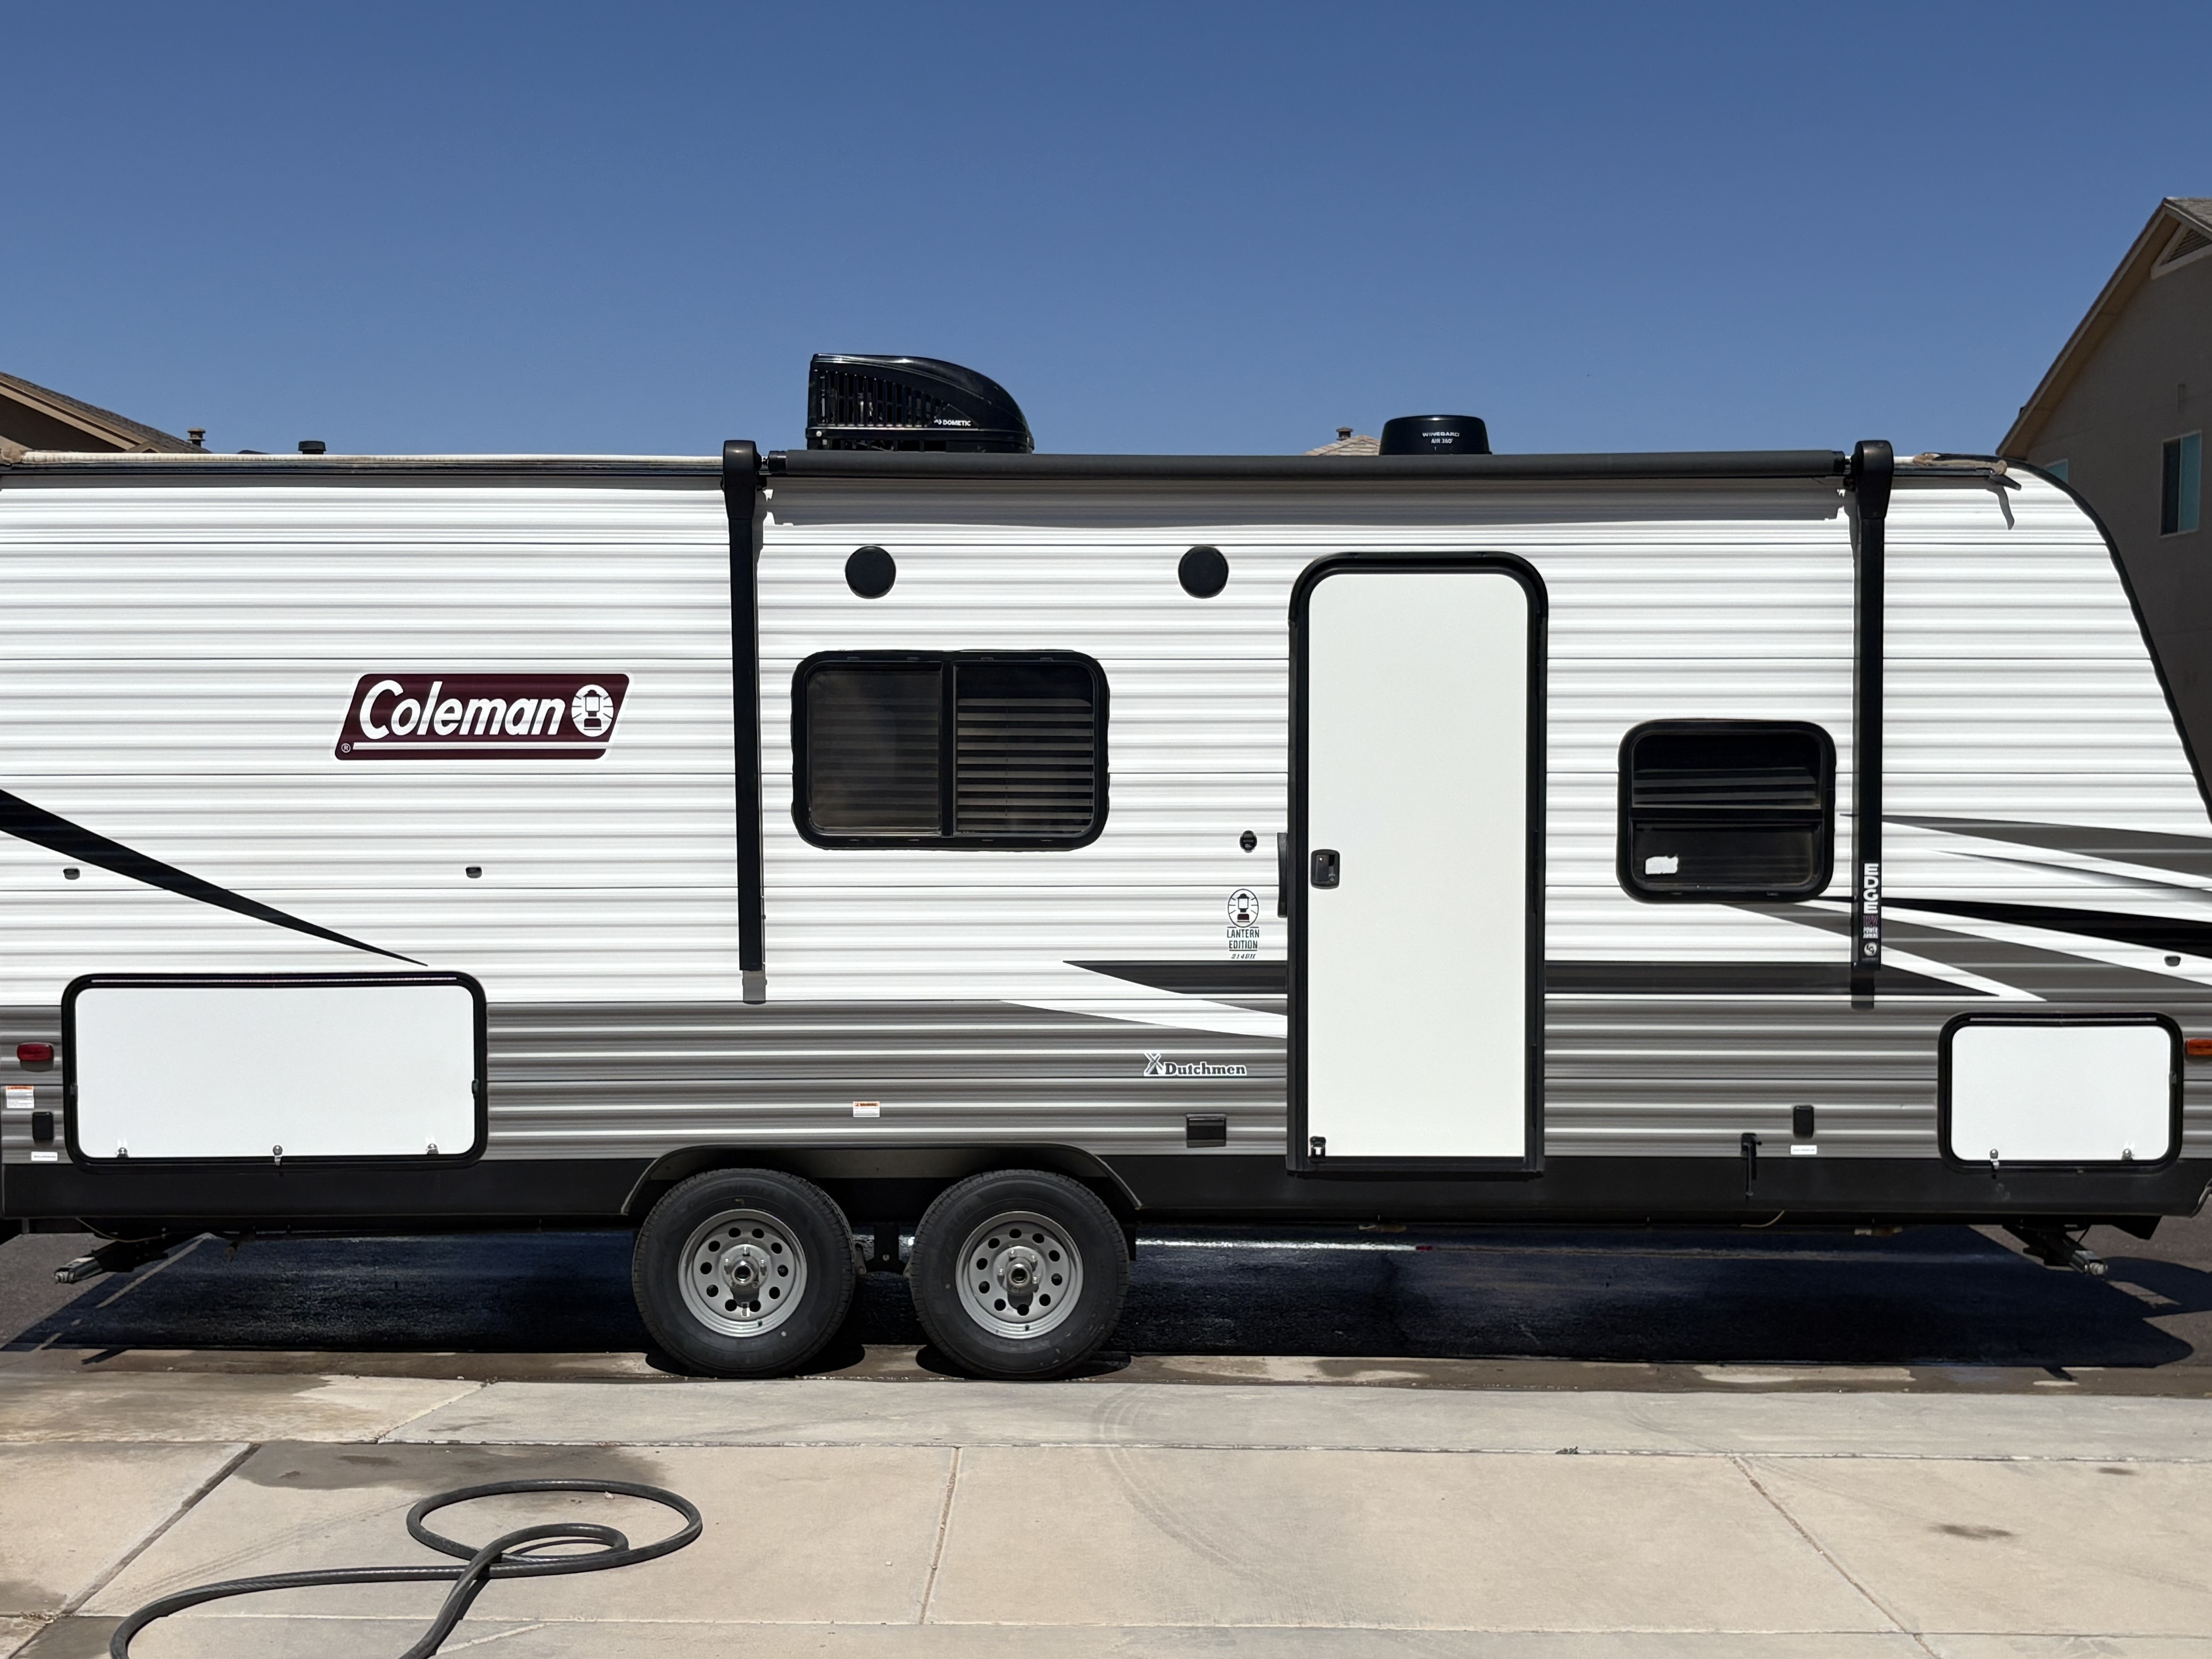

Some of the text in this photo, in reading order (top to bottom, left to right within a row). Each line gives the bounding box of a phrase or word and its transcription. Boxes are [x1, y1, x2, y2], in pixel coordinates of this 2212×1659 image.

[360, 680, 567, 739] Coleman
[1863, 863, 1879, 914] EDGE
[1227, 929, 1259, 938] LANTERN
[1229, 940, 1257, 949] EDITION
[1165, 1062, 1246, 1075] Dutchmen
